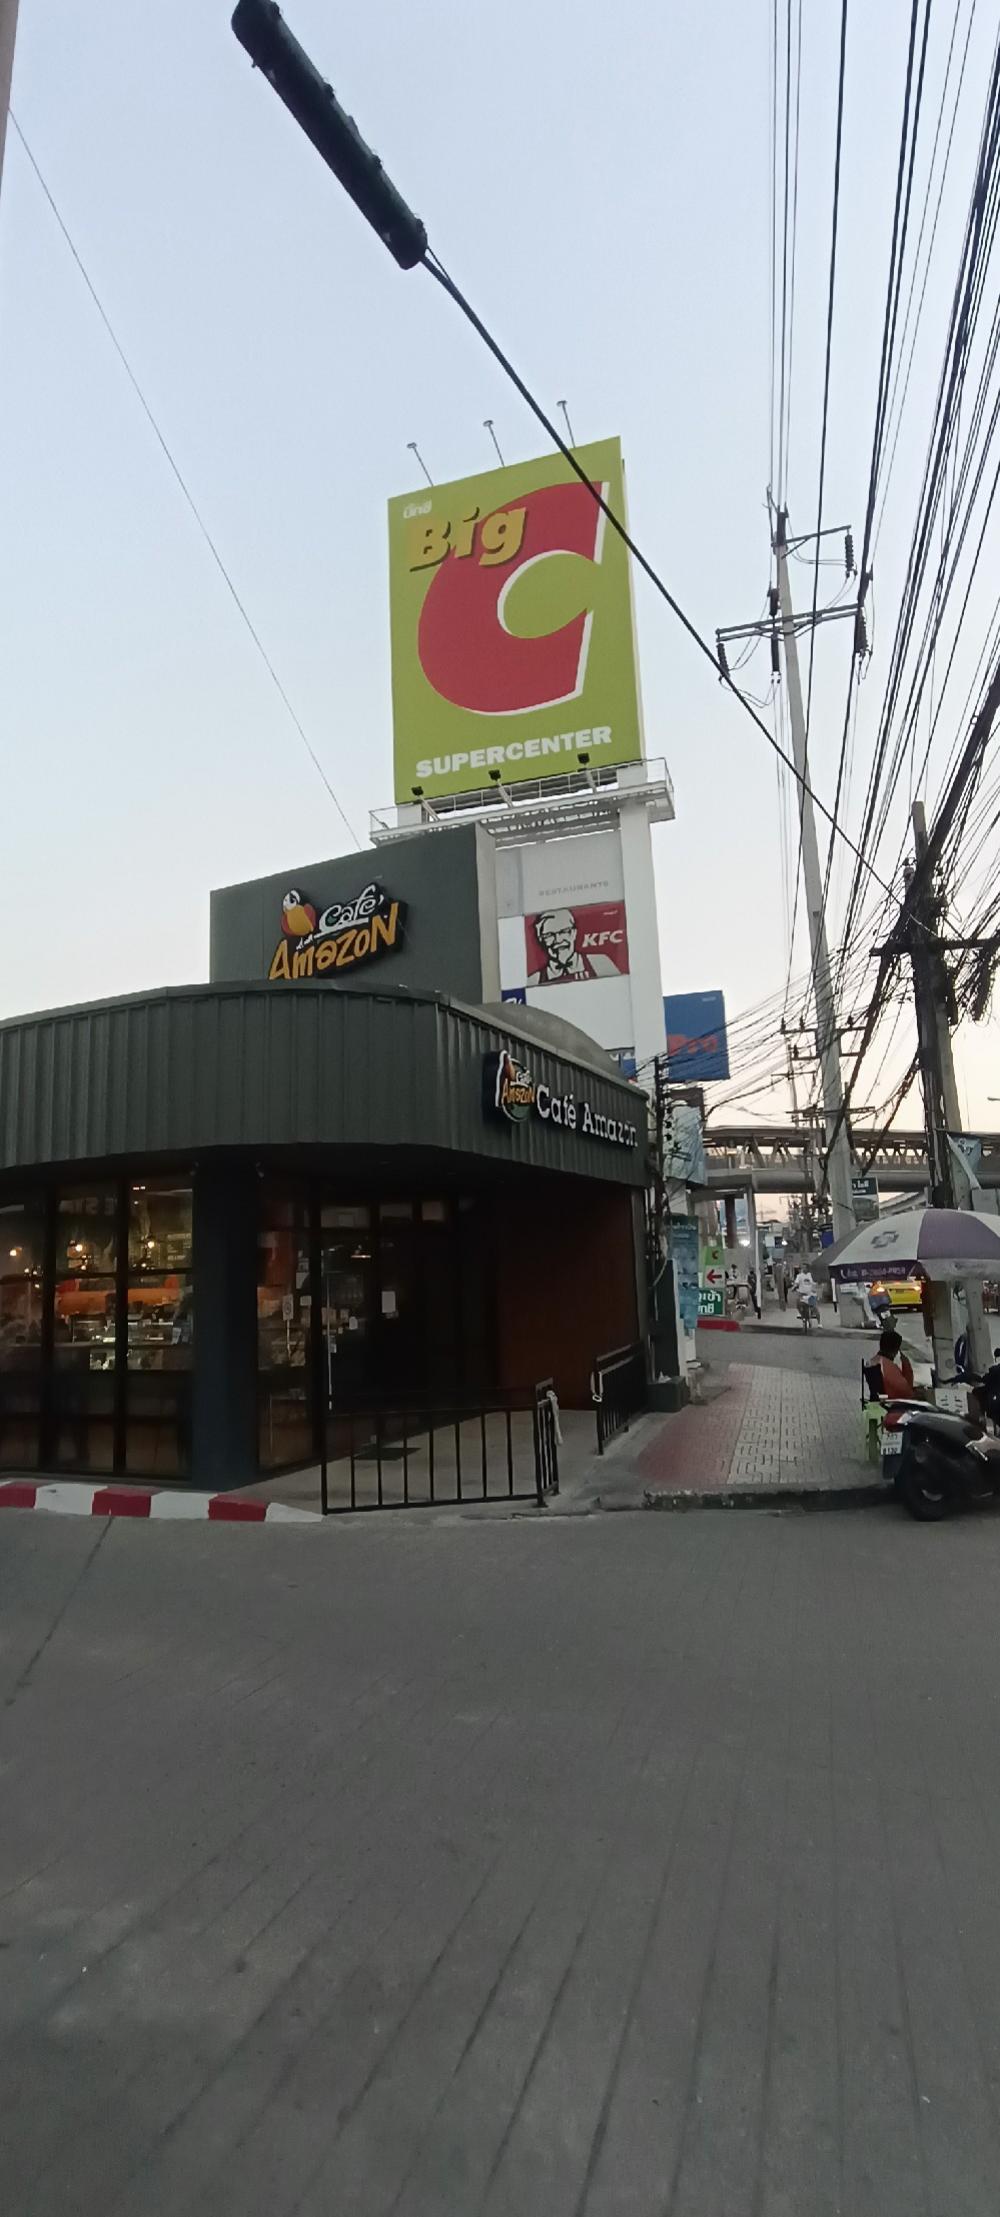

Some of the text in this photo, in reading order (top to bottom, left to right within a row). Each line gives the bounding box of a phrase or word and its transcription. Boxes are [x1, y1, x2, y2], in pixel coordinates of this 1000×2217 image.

[408, 506, 527, 573] Big
[418, 481, 610, 717] C
[416, 726, 612, 778] SUPERCENTER
[538, 881, 609, 897] RESTAURANTS
[582, 930, 624, 948] KFC
[537, 1085, 639, 1148] Café Amazon
